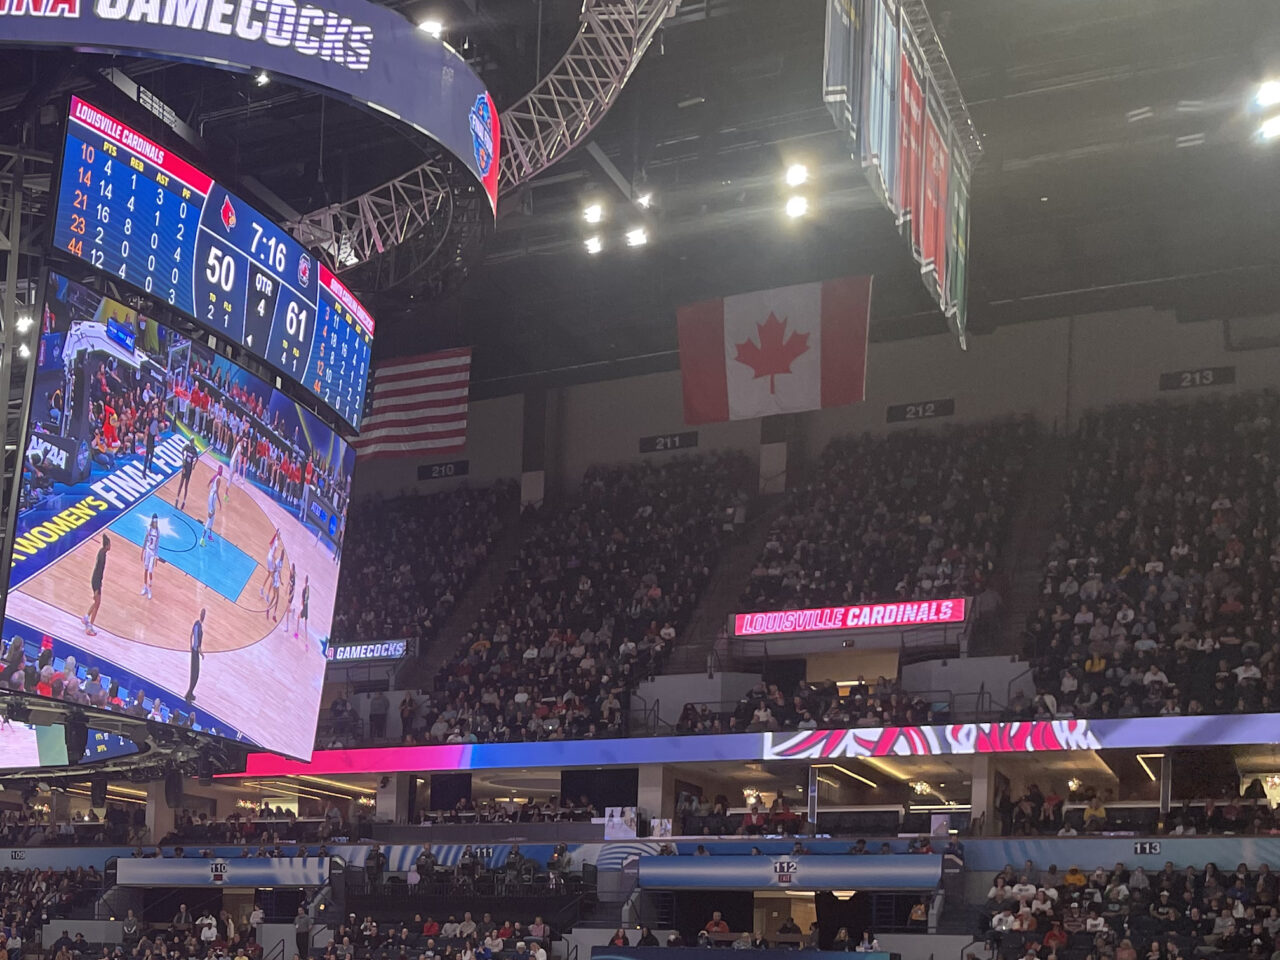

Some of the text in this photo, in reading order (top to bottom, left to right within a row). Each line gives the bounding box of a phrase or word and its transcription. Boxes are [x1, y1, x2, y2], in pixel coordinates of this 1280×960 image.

[75, 102, 164, 164] LOUISVILLE CARDINALS
[250, 222, 286, 273] 7:16
[206, 245, 235, 292] 50
[255, 272, 272, 297] QTR
[257, 299, 266, 317] 4
[286, 301, 307, 342] 61
[1180, 370, 1213, 386] 213
[905, 404, 935, 418] 212
[656, 437, 680, 450] 211
[13, 460, 165, 555] WOMEN'S FINAL
[742, 601, 953, 634] LOUISVILLE CARDINALS
[336, 642, 406, 660] GAMECOCKS
[476, 847, 493, 857] 111
[1134, 841, 1160, 855] 113
[211, 864, 227, 873] 110
[773, 861, 797, 875] 112
